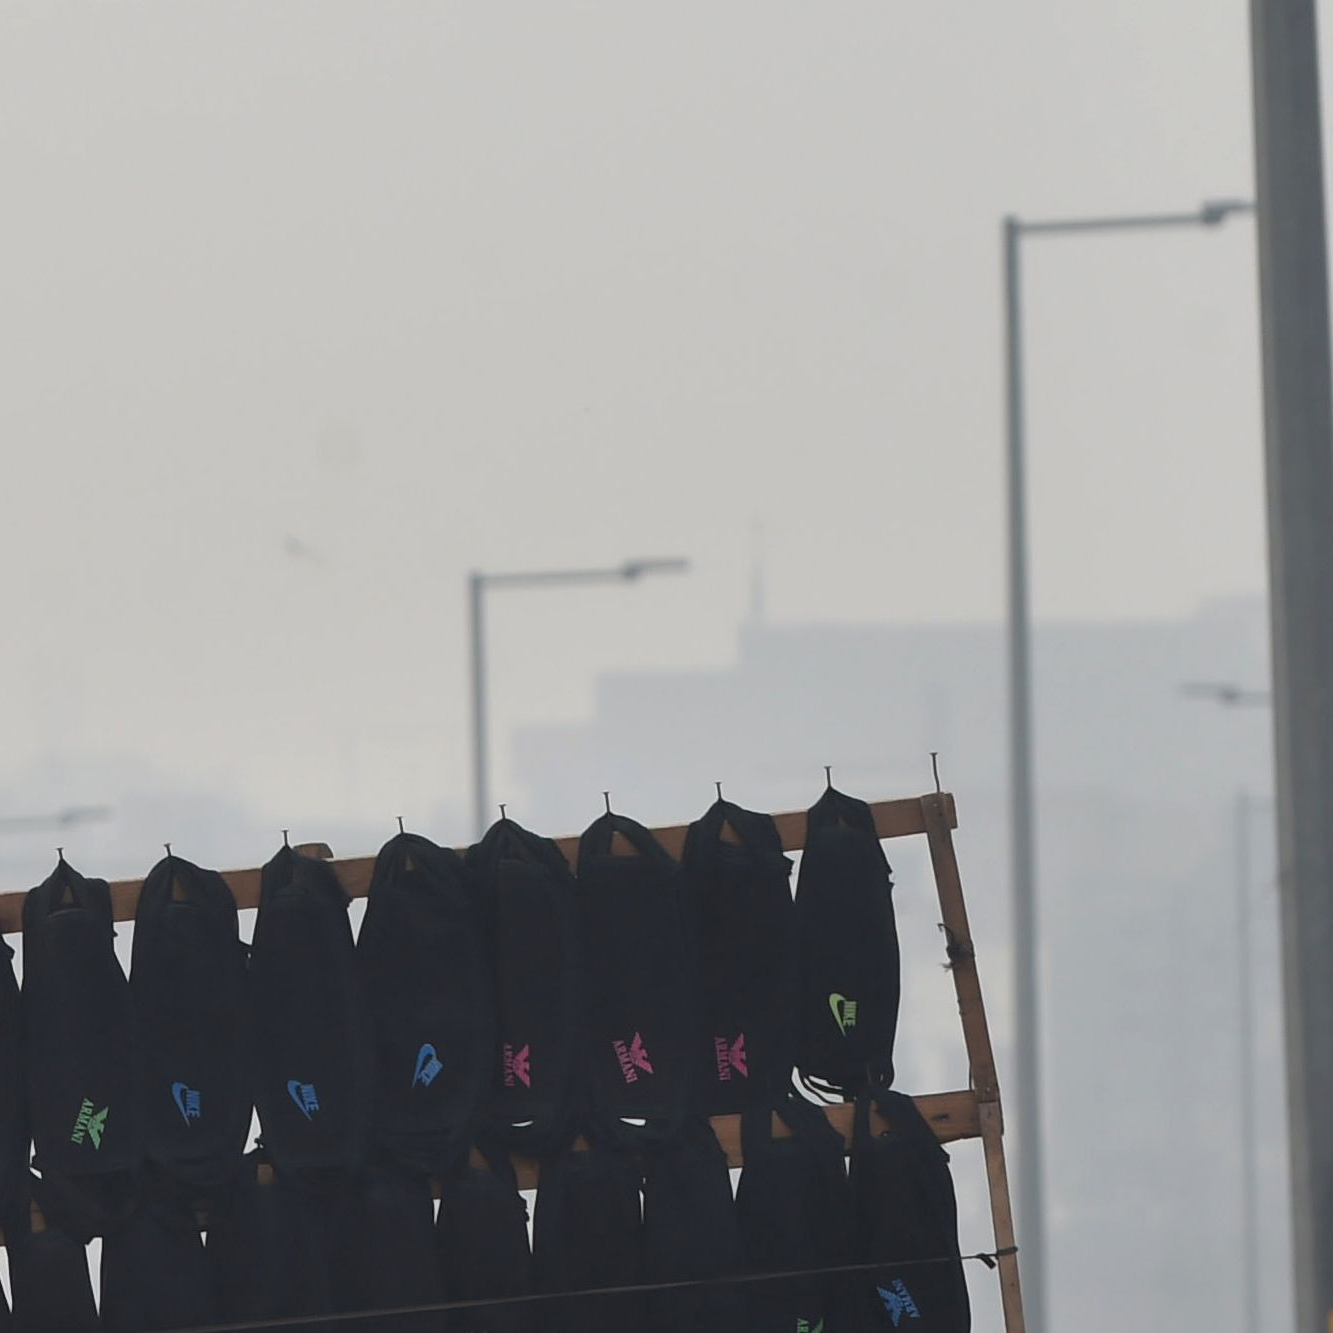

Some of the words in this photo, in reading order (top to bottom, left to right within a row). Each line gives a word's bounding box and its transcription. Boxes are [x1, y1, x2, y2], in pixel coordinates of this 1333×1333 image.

[843, 1000, 857, 1026] NIKE
[503, 1042, 515, 1087] ARMANI
[611, 1040, 638, 1083] ARMANI
[714, 1037, 730, 1081] ARMANI
[186, 1089, 201, 1118] NIKE
[300, 1083, 320, 1111] NIKE
[71, 1097, 94, 1145] ARMANI
[891, 1278, 921, 1318] ARMANI
